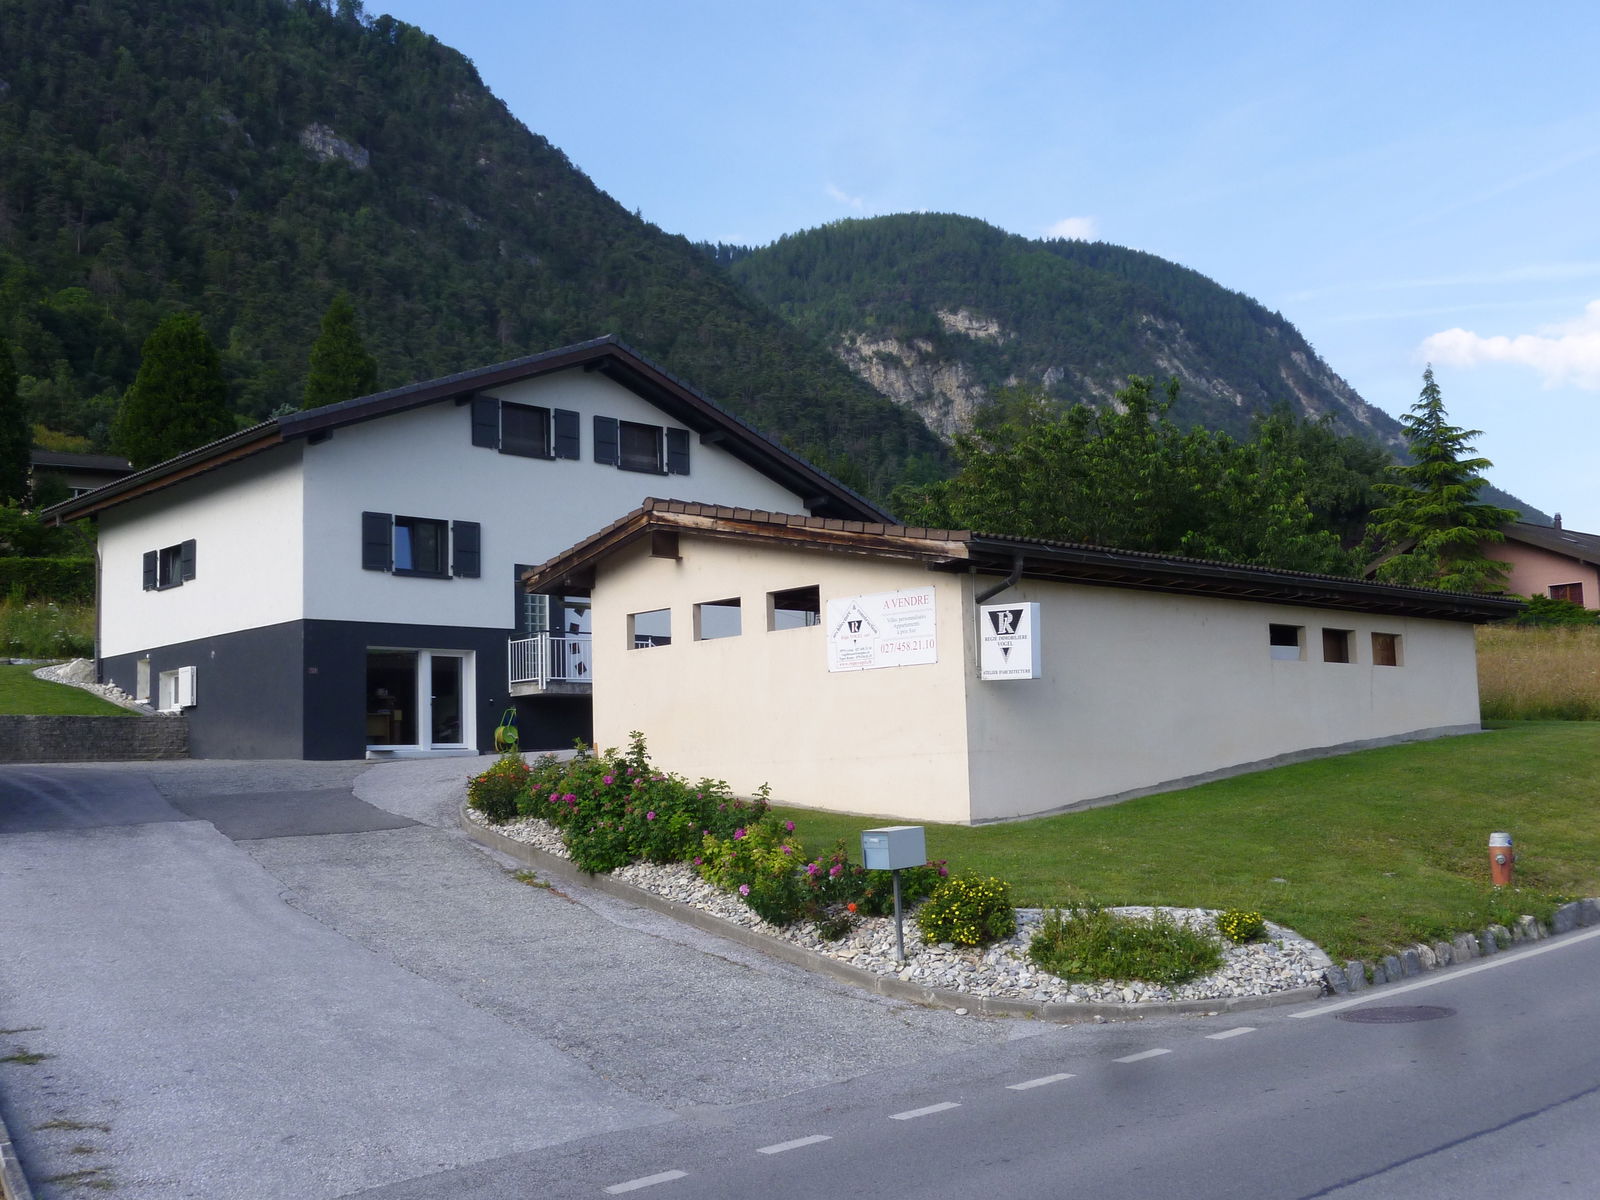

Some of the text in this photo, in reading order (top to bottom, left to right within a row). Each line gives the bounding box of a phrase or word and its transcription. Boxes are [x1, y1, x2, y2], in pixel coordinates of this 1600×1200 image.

[883, 594, 929, 610] A VENDRE
[880, 639, 935, 654] 027/458.21.10
